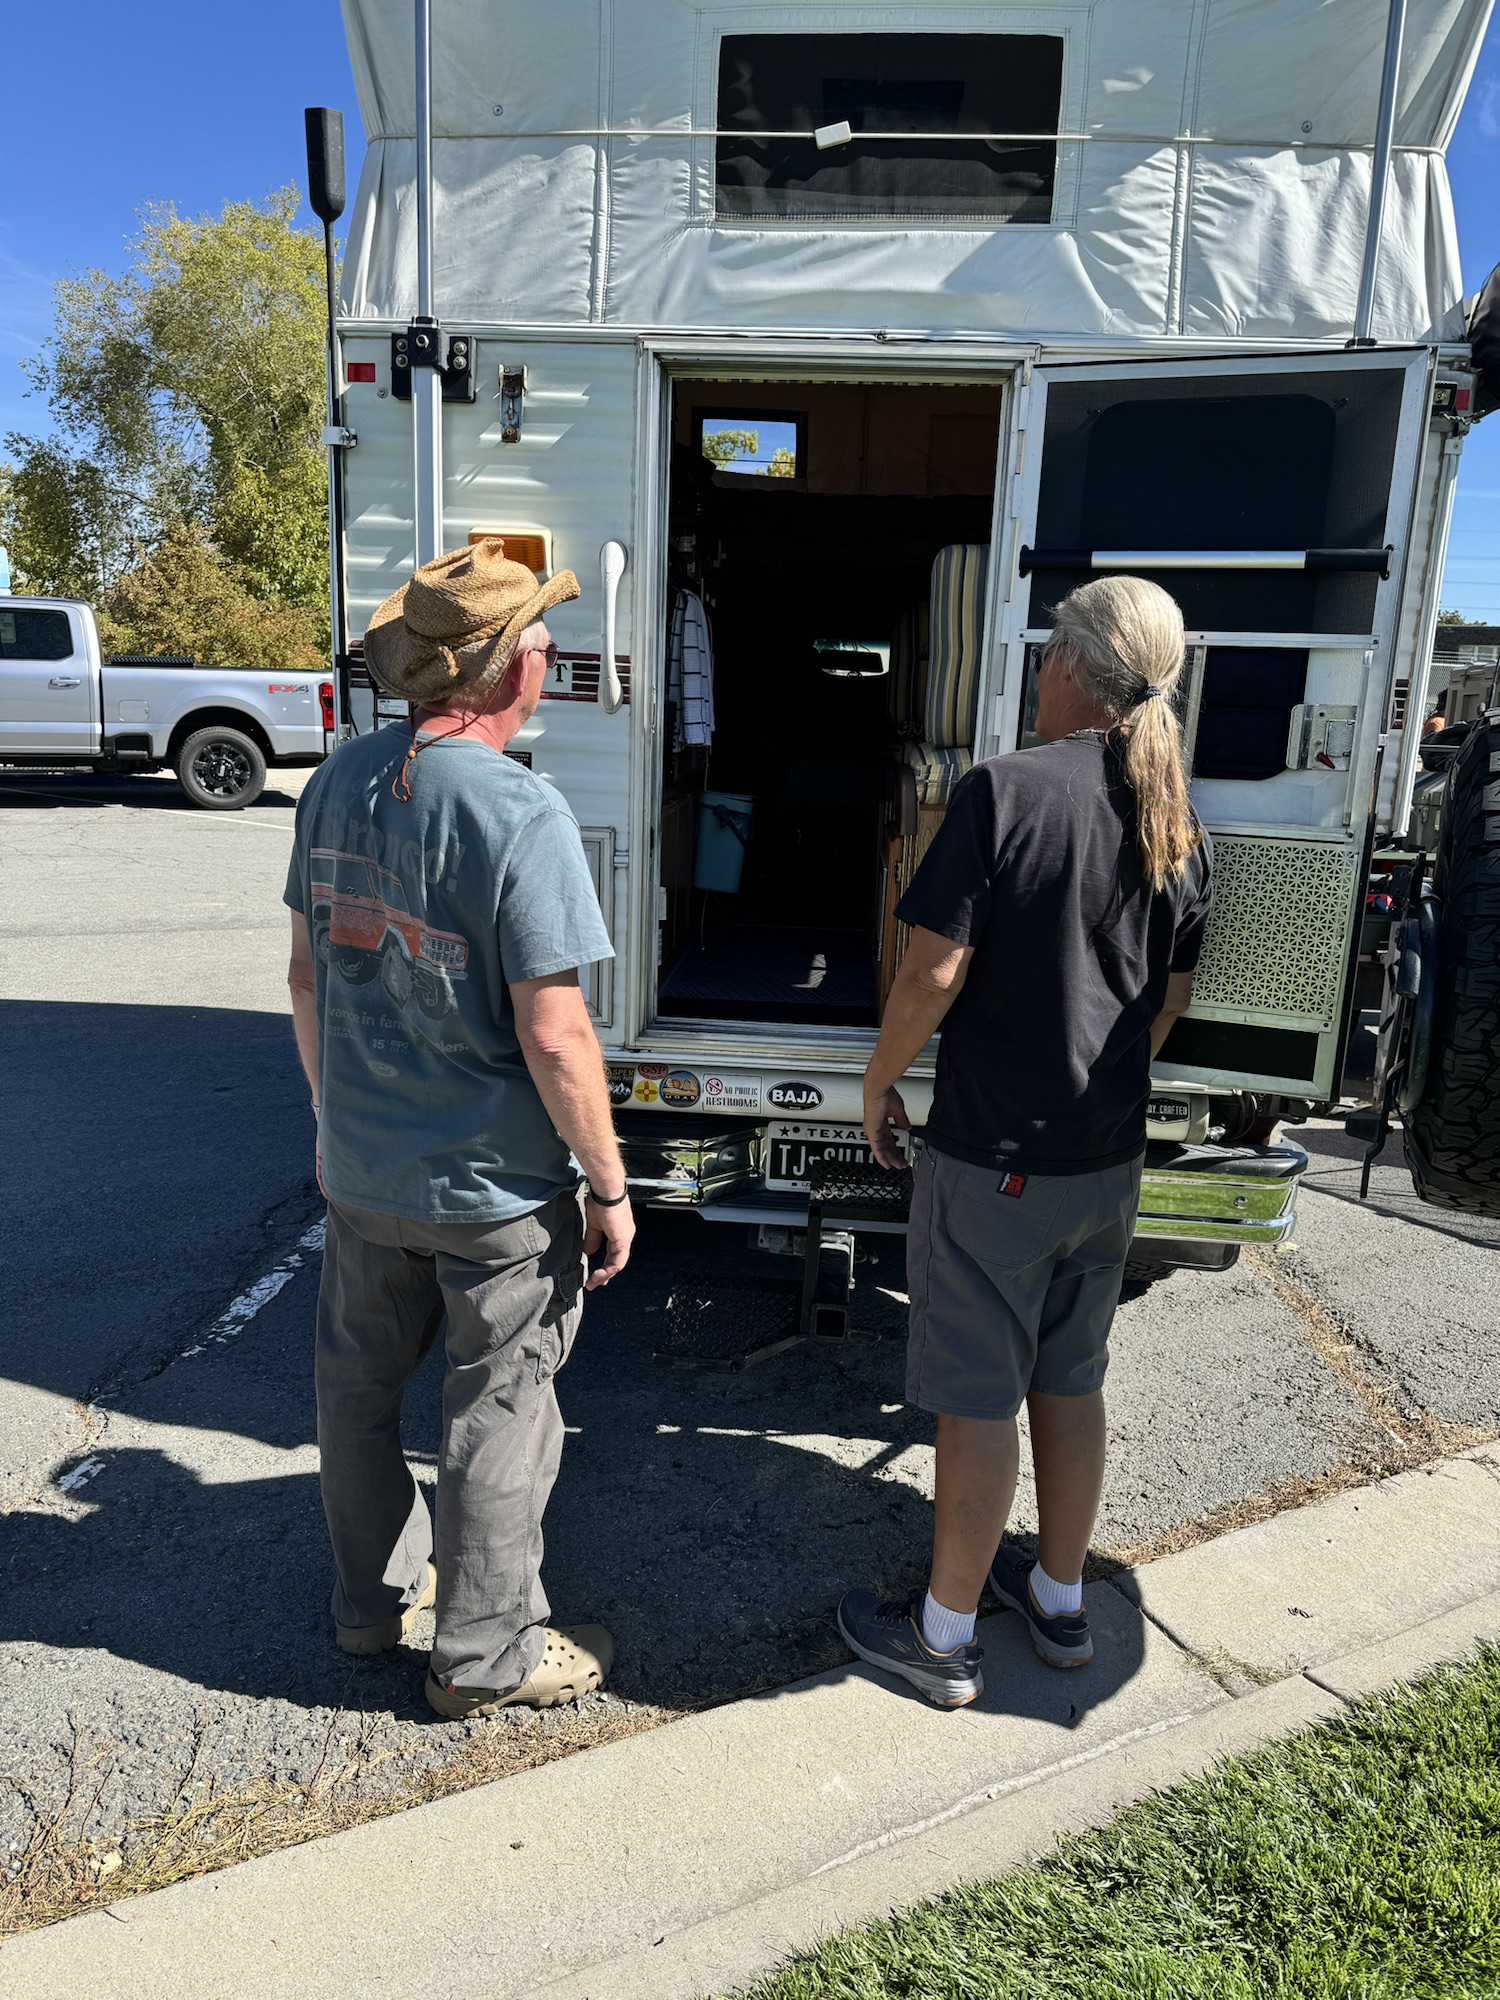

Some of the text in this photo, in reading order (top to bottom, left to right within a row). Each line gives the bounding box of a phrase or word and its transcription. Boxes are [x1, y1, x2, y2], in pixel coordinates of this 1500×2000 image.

[268, 684, 309, 694] FX4
[361, 1012, 375, 1026] in
[372, 1038, 386, 1049] 15
[641, 1063, 666, 1075] GSP
[724, 1086, 758, 1096] NO PUBLIC
[772, 1089, 820, 1104] BAJA
[706, 1097, 758, 1108] RESTROOMS
[807, 1128, 868, 1140] TEXAS
